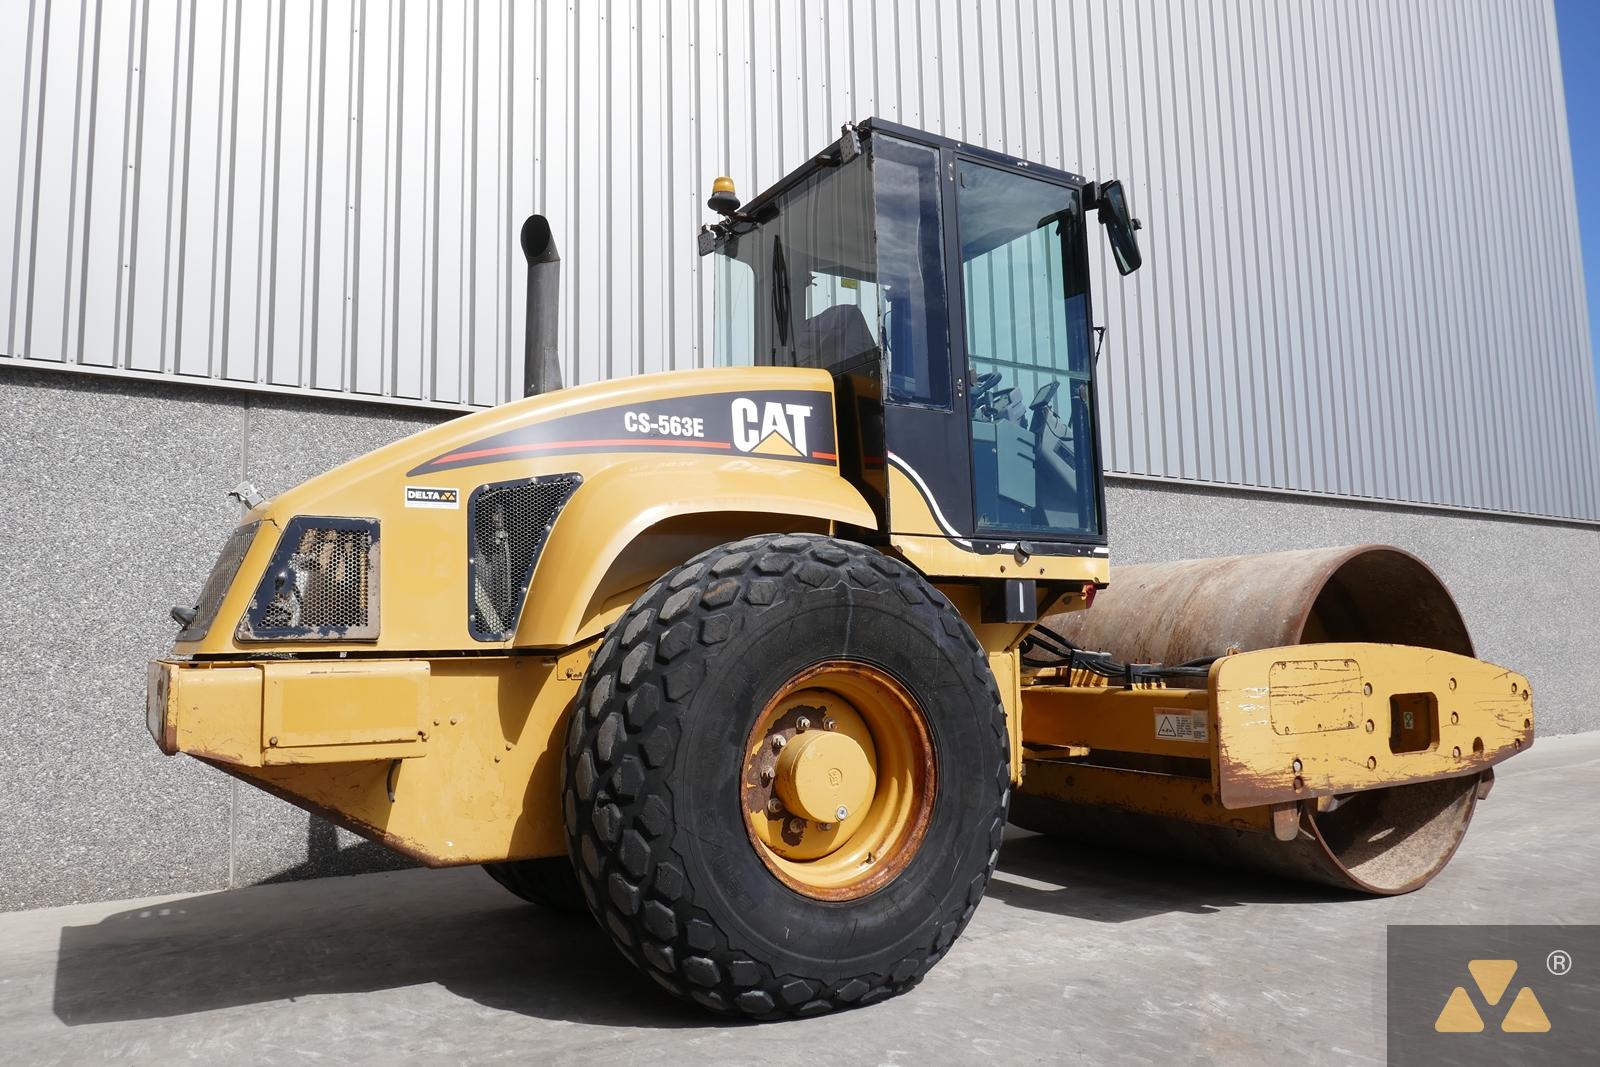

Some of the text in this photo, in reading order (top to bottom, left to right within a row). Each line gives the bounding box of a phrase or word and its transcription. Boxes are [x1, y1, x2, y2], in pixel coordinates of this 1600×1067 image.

[624, 411, 705, 438] CS-563E
[731, 397, 813, 457] CAT
[407, 490, 441, 500] DELTA
